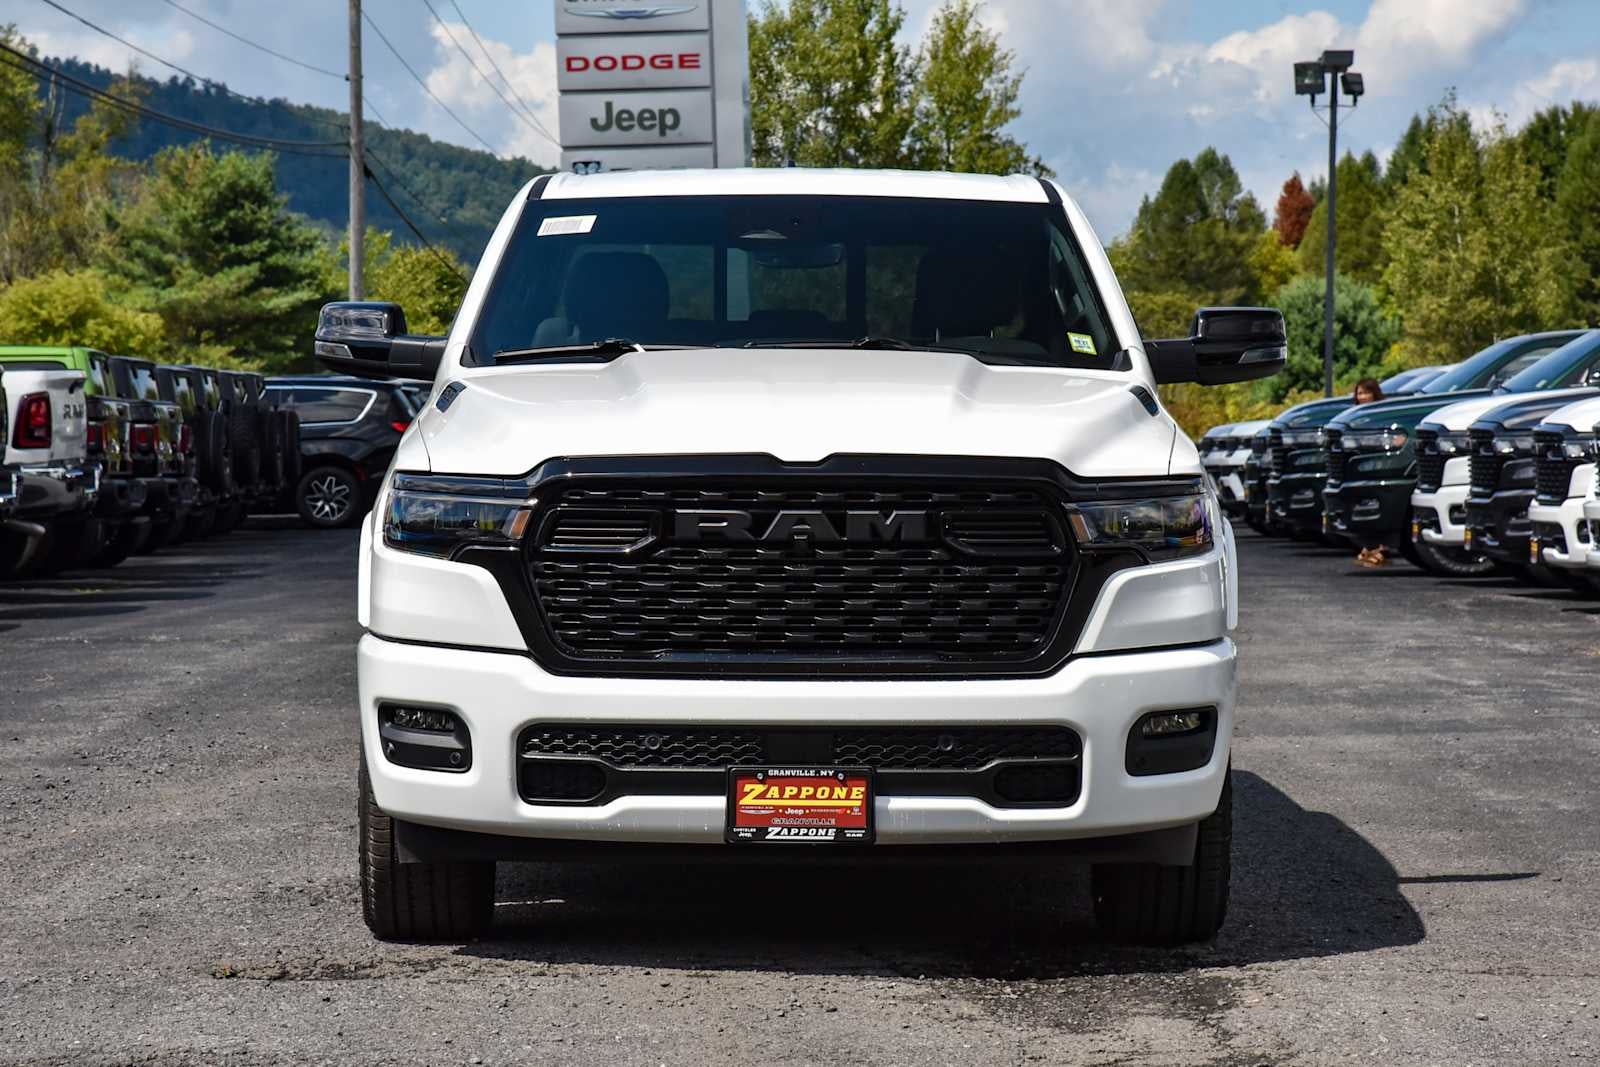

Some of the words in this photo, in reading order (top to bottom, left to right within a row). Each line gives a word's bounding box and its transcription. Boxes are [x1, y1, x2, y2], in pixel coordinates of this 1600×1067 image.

[565, 53, 701, 72] DODGE
[590, 101, 681, 137] Jeep
[674, 508, 928, 542] RAM
[739, 784, 866, 806] ZAPPONE
[784, 808, 805, 816] Jeep
[765, 827, 837, 840] ZAPPONE
